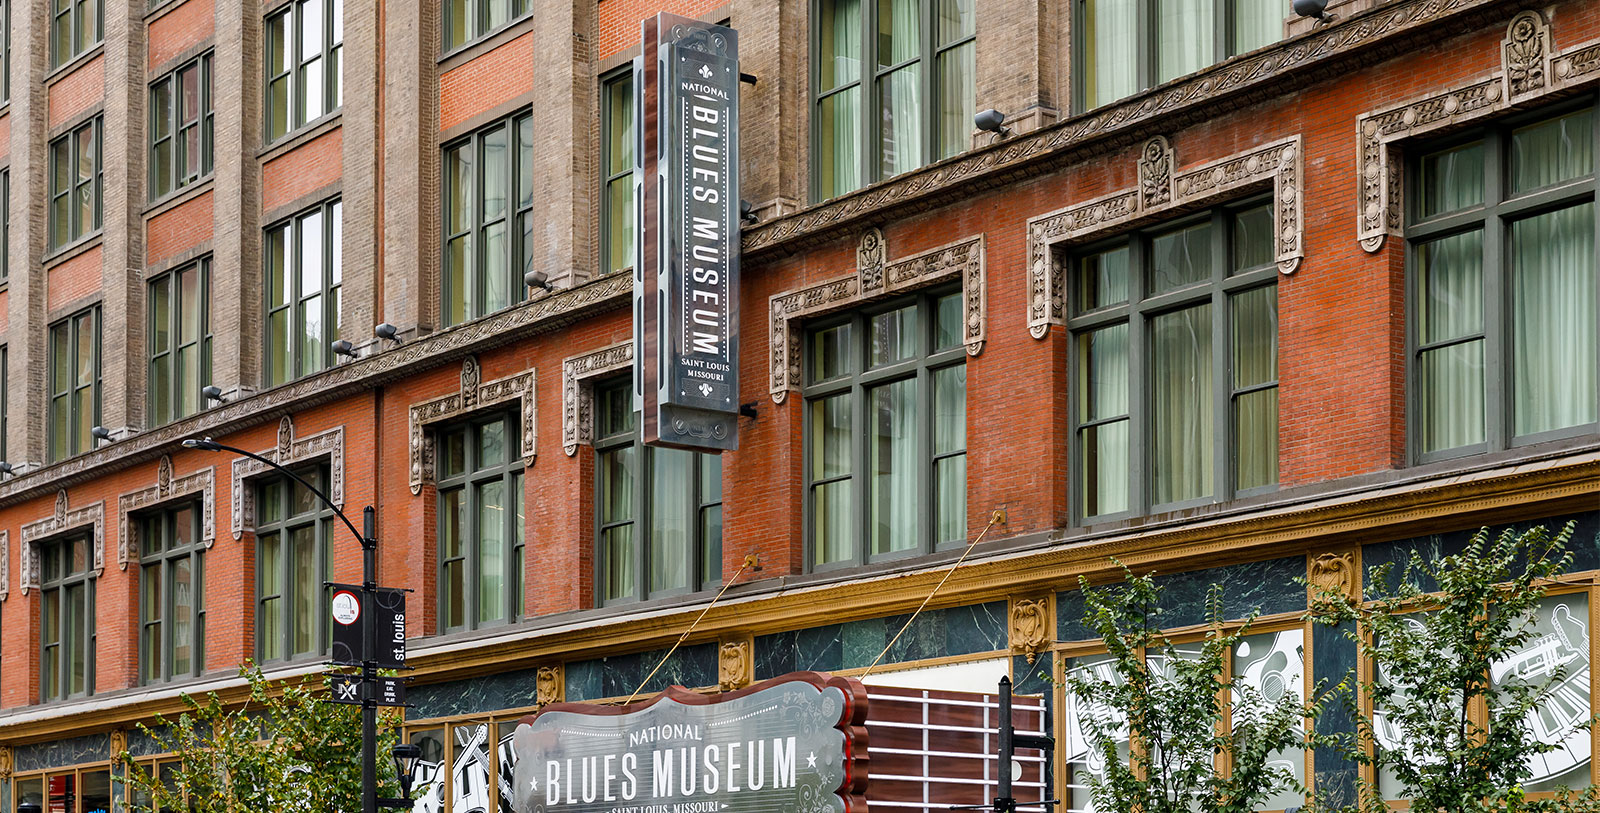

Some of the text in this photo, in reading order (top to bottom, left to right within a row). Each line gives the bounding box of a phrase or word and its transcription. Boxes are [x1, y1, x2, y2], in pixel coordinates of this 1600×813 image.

[681, 82, 730, 101] NATIONAL
[692, 105, 719, 355] BLUES MUSEUM
[681, 357, 730, 372] SAINT LOUIS
[687, 369, 724, 381] MISSOURI
[392, 613, 405, 661] st. louis
[628, 724, 703, 747] NATIONAL
[546, 736, 797, 806] BLUES MUSEUM
[673, 801, 719, 813] MISSOURI
